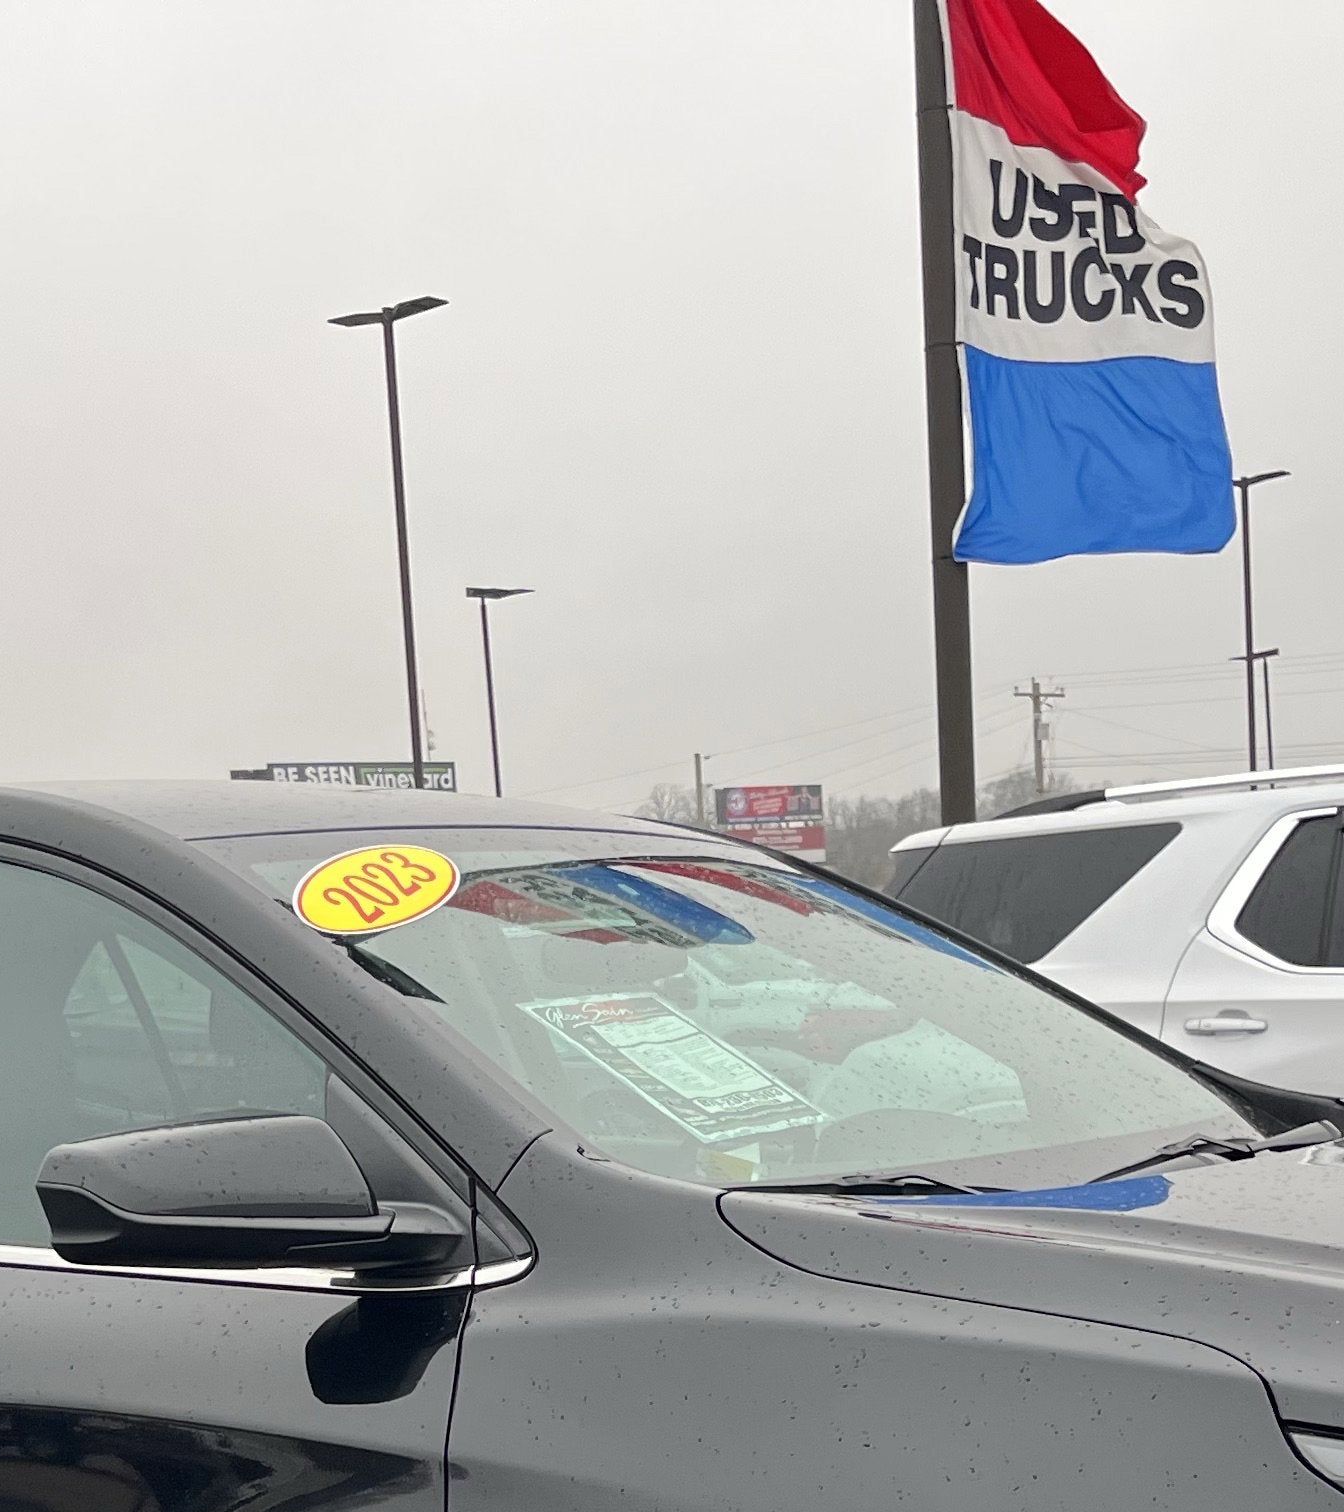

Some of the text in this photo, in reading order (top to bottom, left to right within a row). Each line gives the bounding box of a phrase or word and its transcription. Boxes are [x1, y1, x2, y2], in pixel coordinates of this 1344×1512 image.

[989, 158, 1146, 254] USED
[962, 233, 1205, 329] TRUCKS
[272, 766, 299, 782] BE
[304, 765, 356, 785] SEEN
[322, 851, 437, 924] 2023
